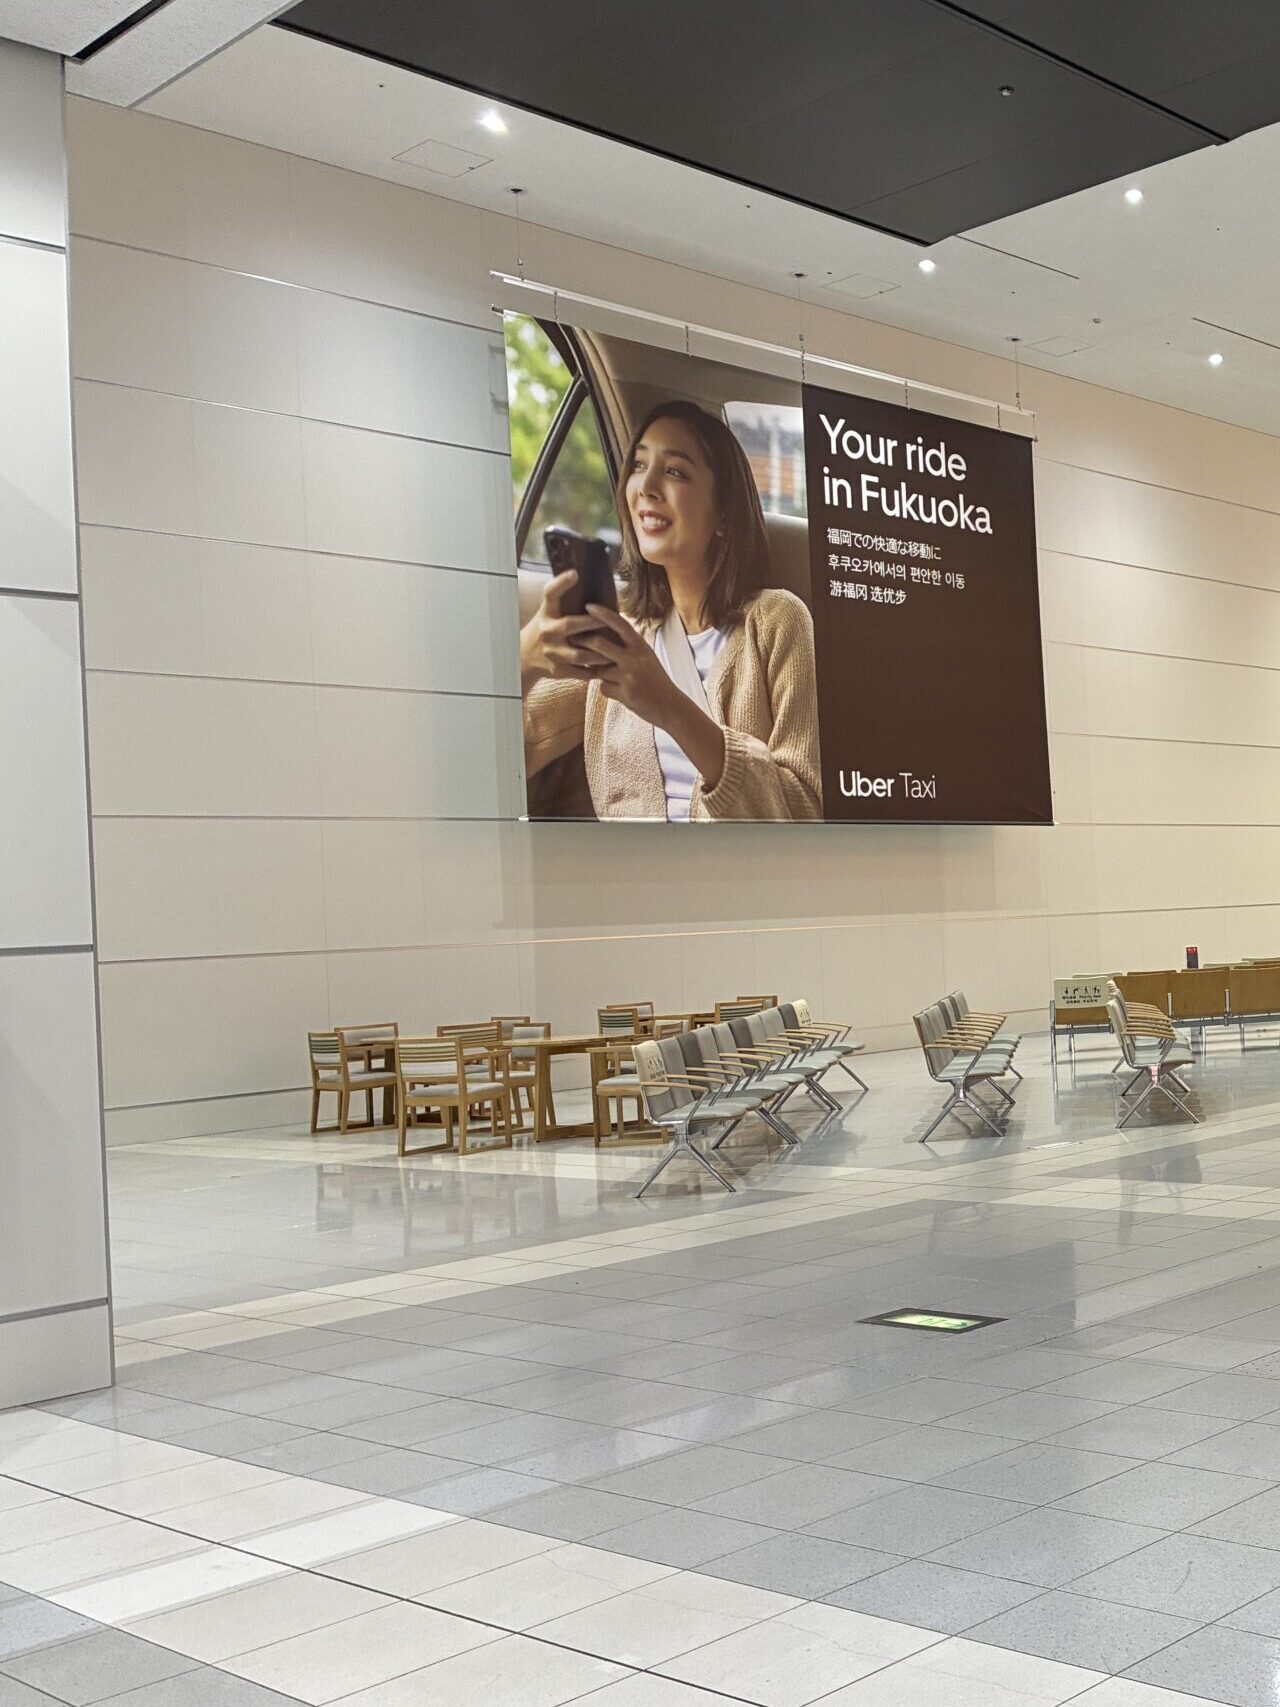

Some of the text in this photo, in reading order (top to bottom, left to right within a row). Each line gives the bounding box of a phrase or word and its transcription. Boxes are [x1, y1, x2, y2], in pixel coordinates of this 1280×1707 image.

[819, 413, 967, 482] Your ride
[822, 466, 993, 535] in Fukuoka
[827, 527, 942, 560] 福岡での快適な移動に
[828, 553, 966, 590] 후쿠오카에서의 편안한 이동
[829, 579, 907, 605] 游福冈 选优步
[839, 769, 937, 799] Uber Taxi
